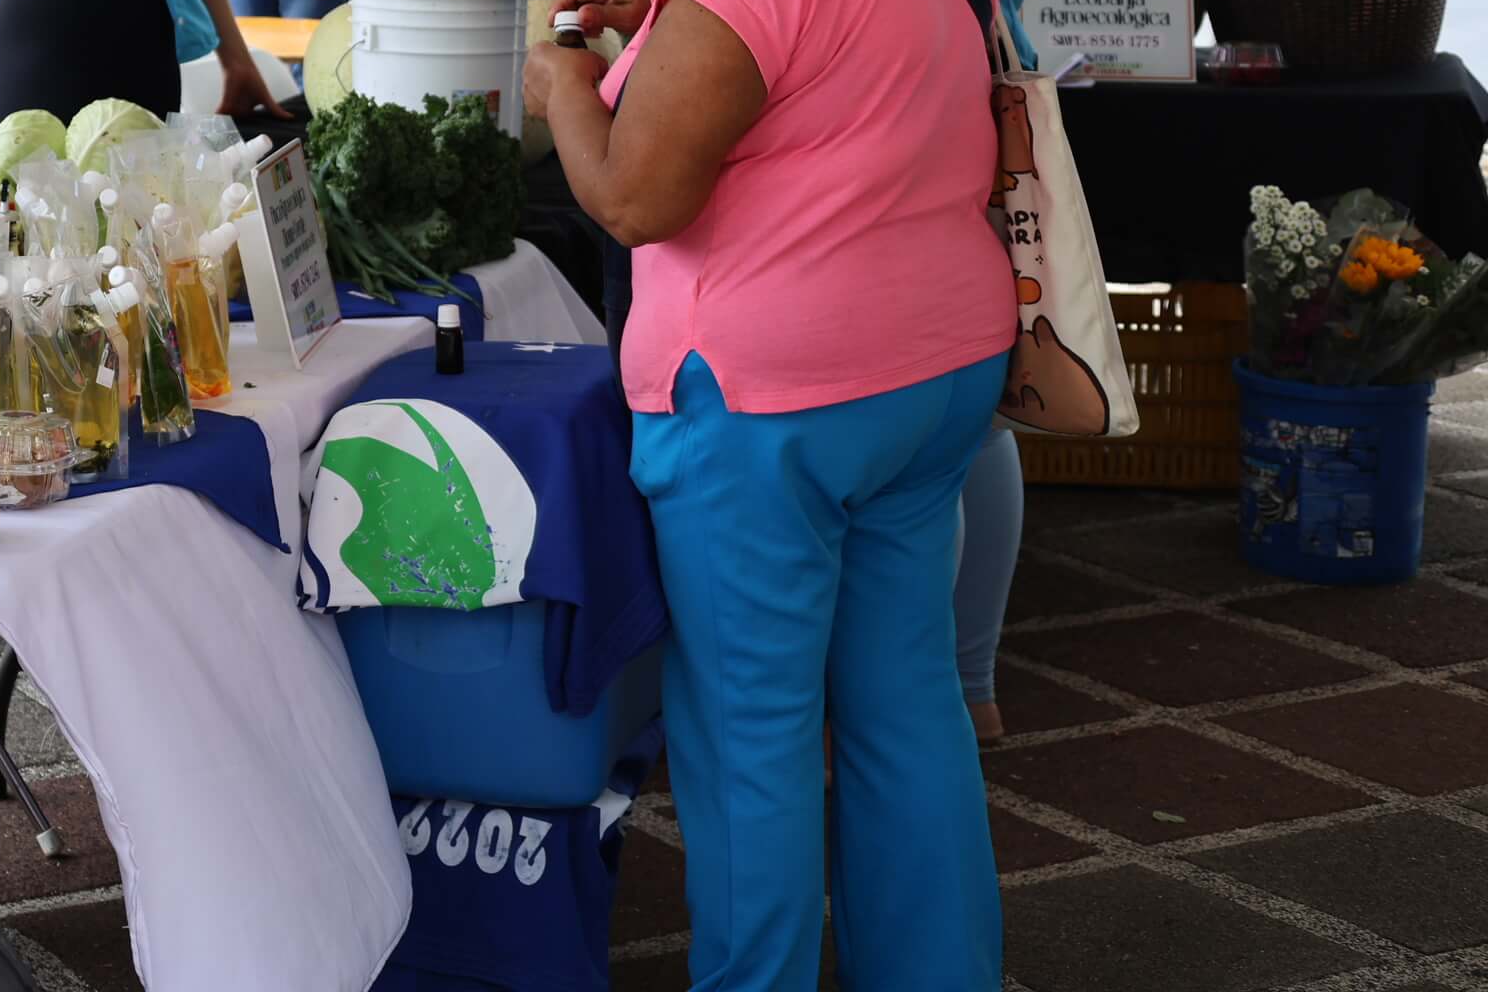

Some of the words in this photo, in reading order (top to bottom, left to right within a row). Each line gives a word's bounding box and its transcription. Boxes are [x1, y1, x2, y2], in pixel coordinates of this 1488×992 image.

[1040, 6, 1171, 28] Agroecológica
[1091, 34, 1124, 48] 8536
[1130, 35, 1160, 49] 1775
